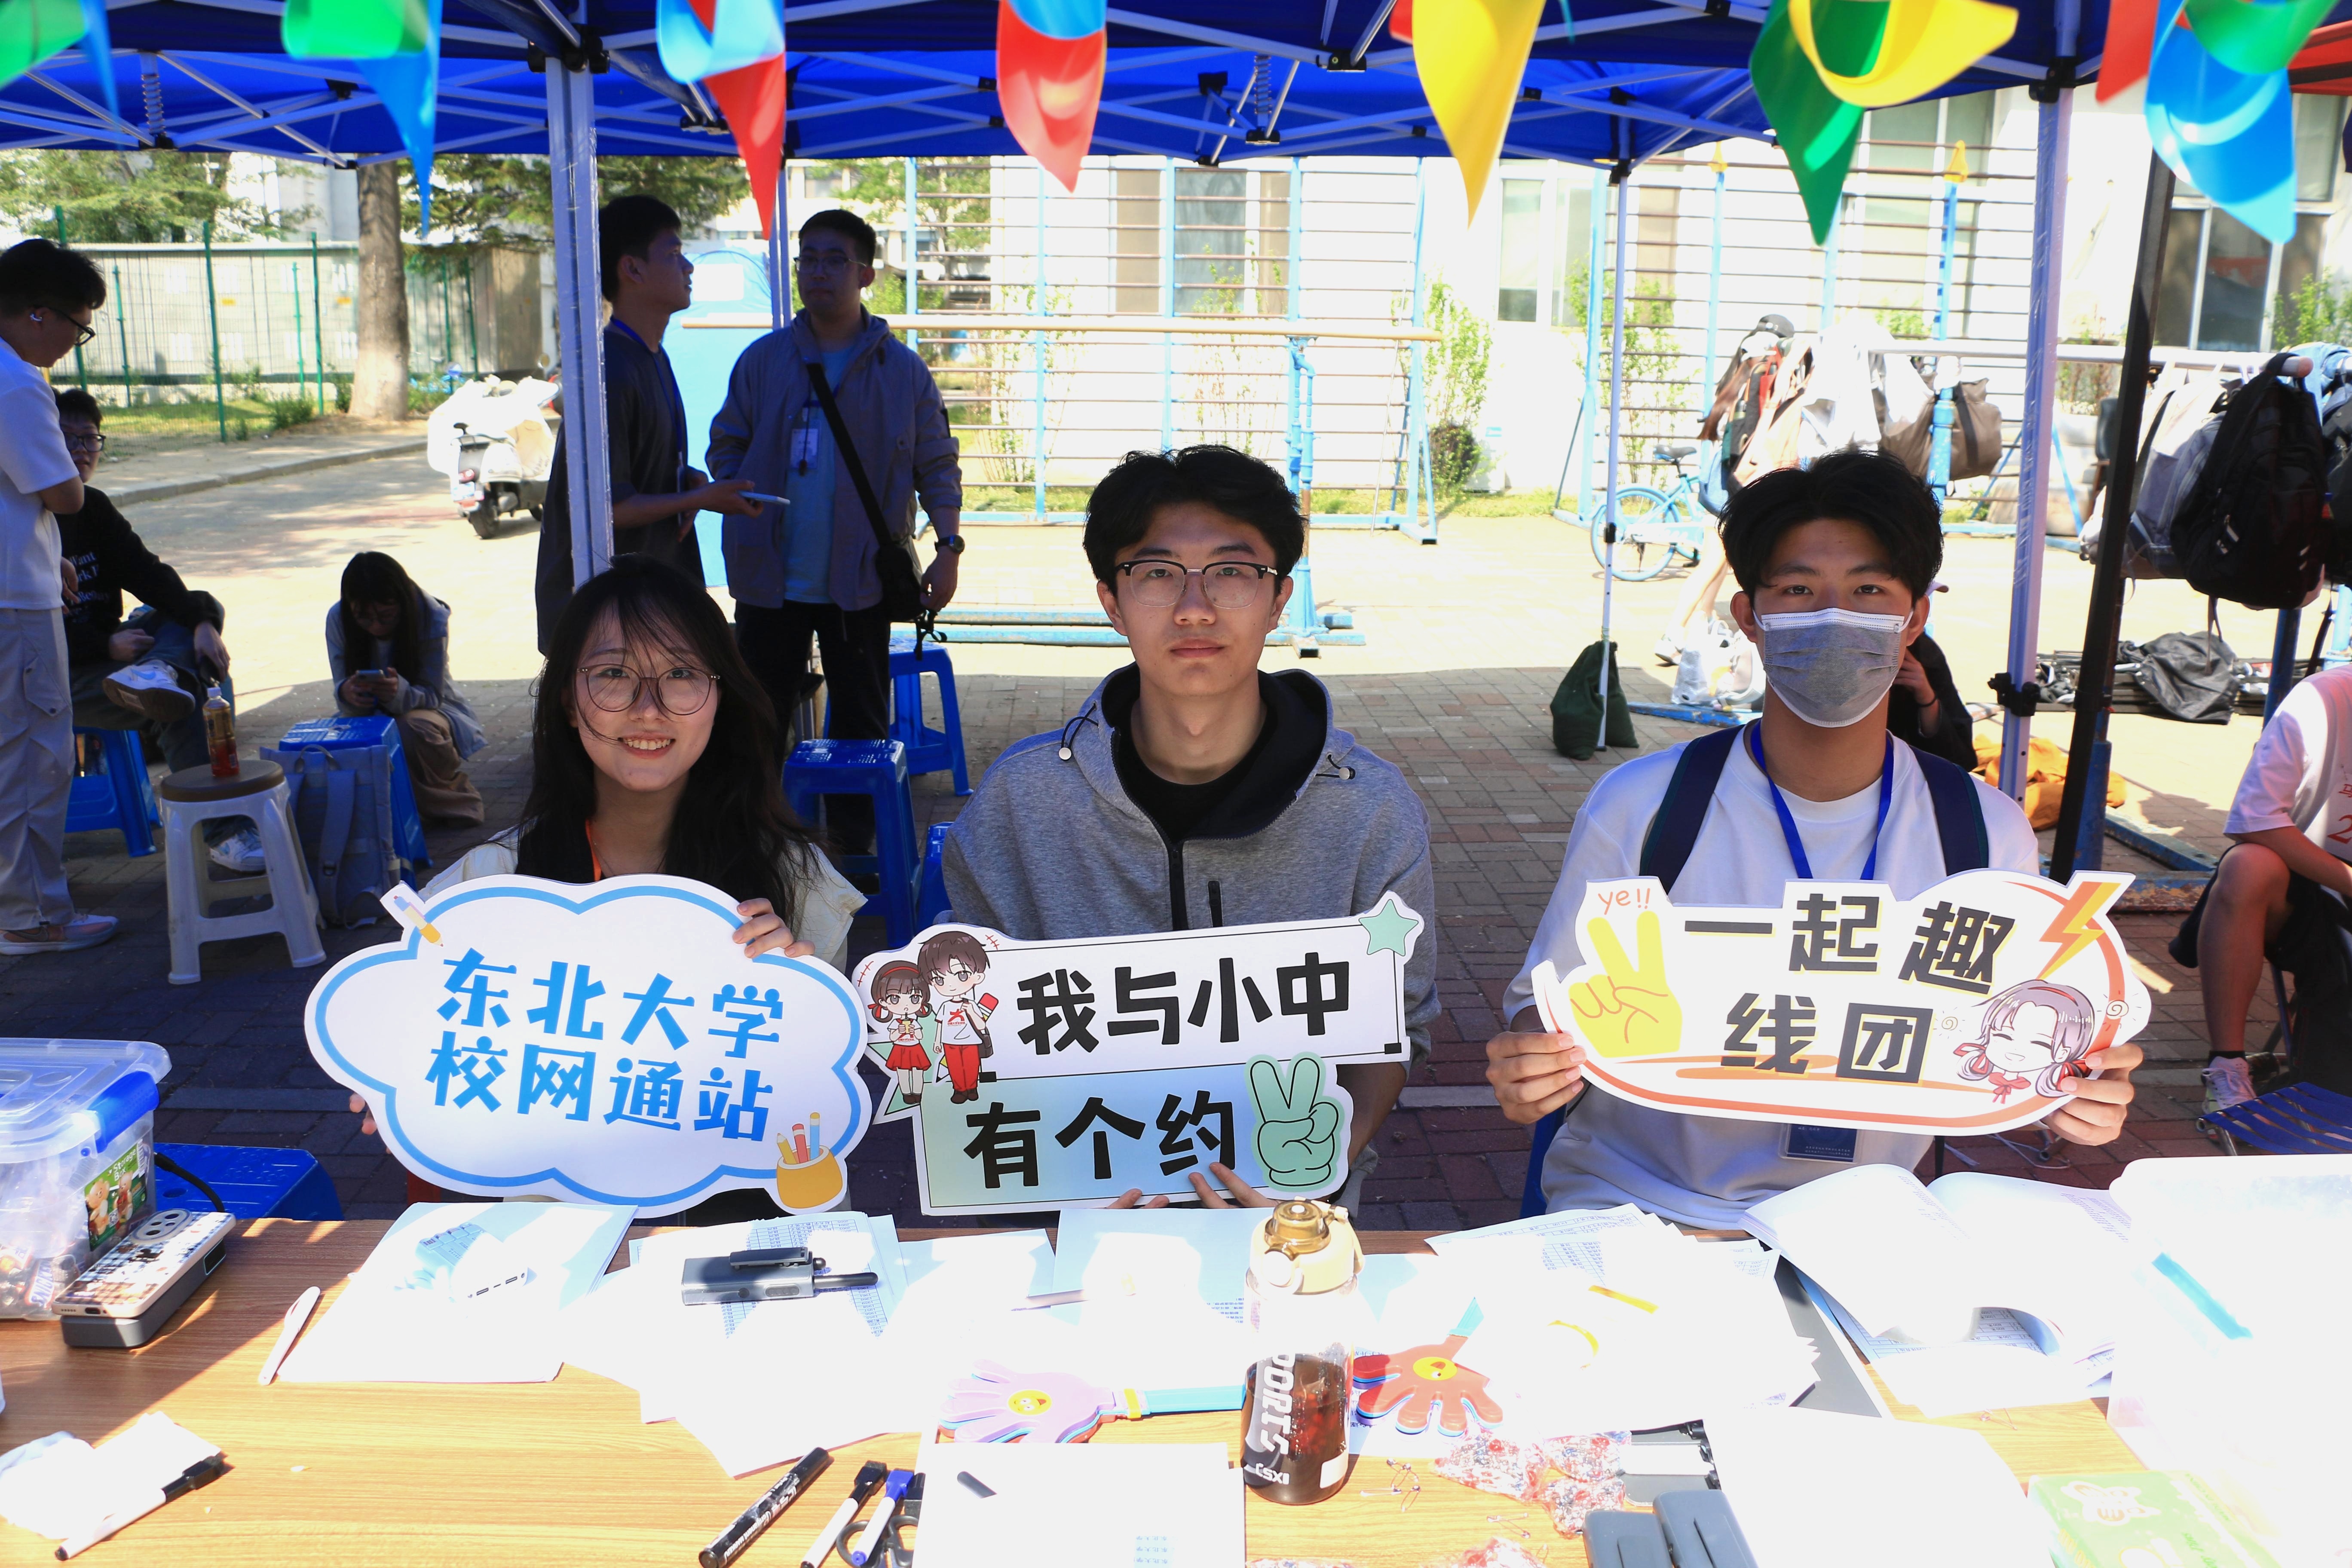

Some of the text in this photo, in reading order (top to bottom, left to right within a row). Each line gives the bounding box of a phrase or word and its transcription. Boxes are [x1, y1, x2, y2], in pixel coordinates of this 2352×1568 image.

[1684, 893, 2015, 995] 一起趣
[437, 947, 784, 1059] 东北大学
[1017, 952, 1350, 1055] 我与小中
[1721, 992, 1934, 1084] 线团
[425, 1031, 773, 1142] 校网通站
[113, 1148, 137, 1172] Storage
[114, 1167, 126, 1182] Box
[963, 1090, 1236, 1189] 有个约
